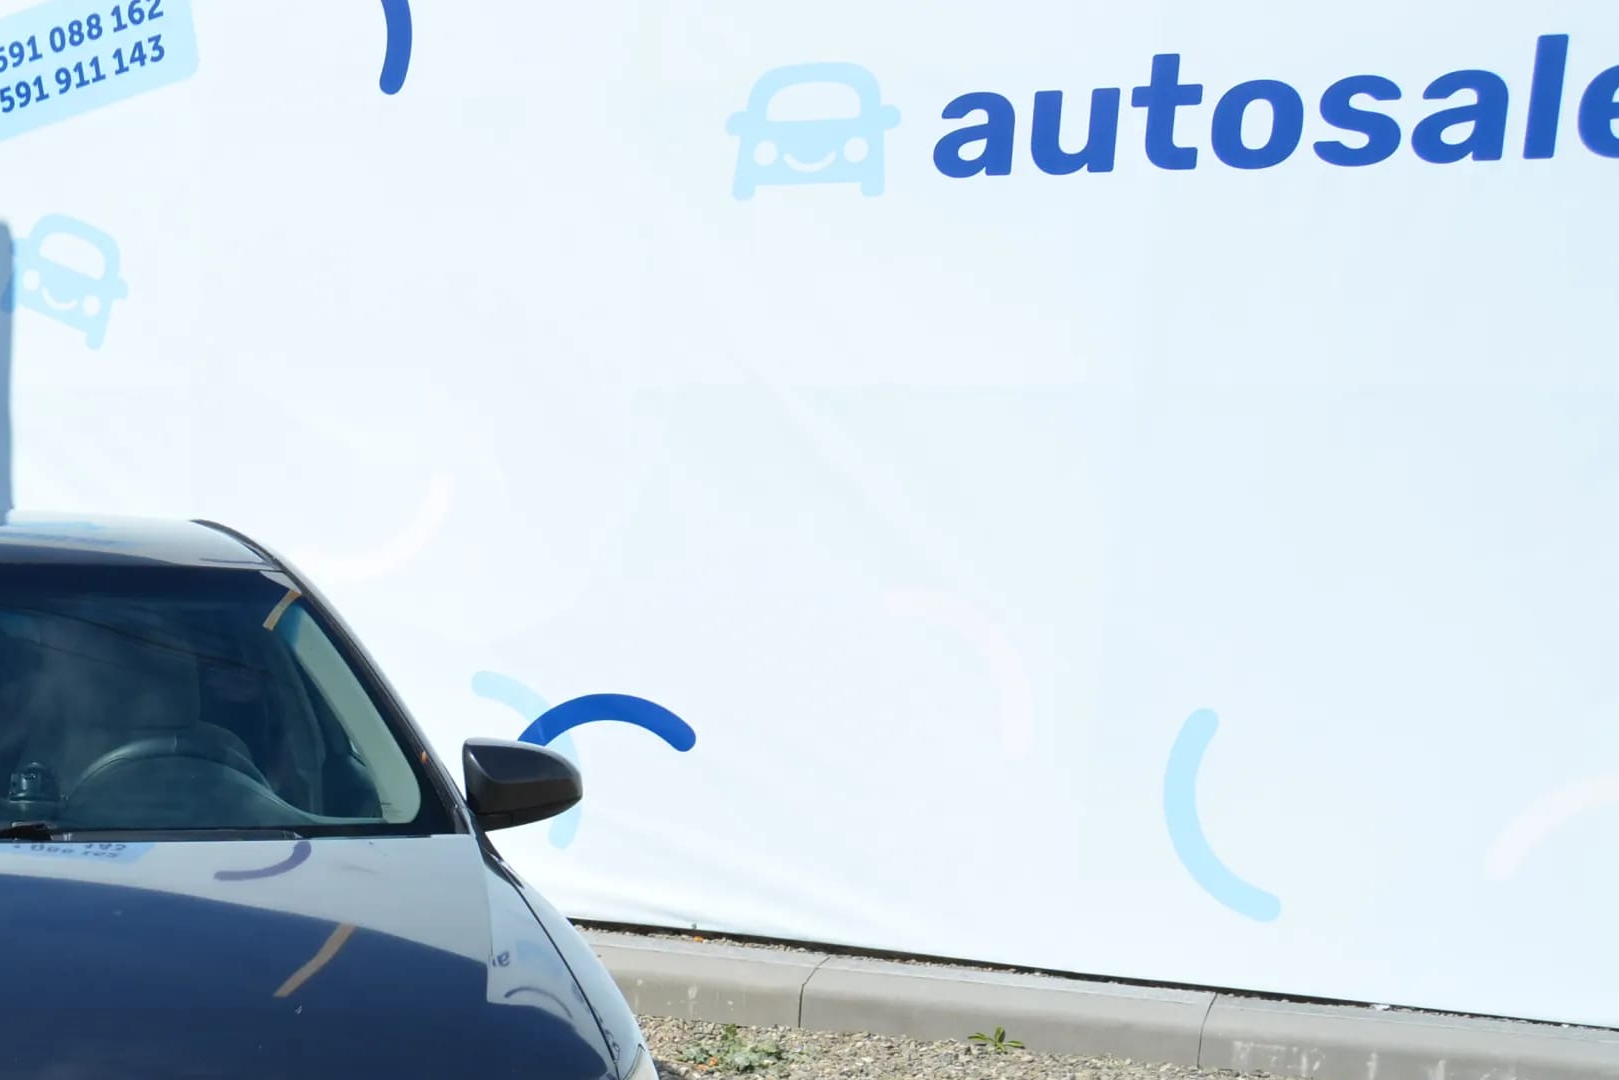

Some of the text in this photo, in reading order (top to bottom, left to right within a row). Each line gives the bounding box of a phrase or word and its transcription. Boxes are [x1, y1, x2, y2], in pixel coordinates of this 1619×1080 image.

[49, 13, 103, 54] 088
[111, 0, 164, 33] 162
[0, 34, 165, 114] 591 911 143
